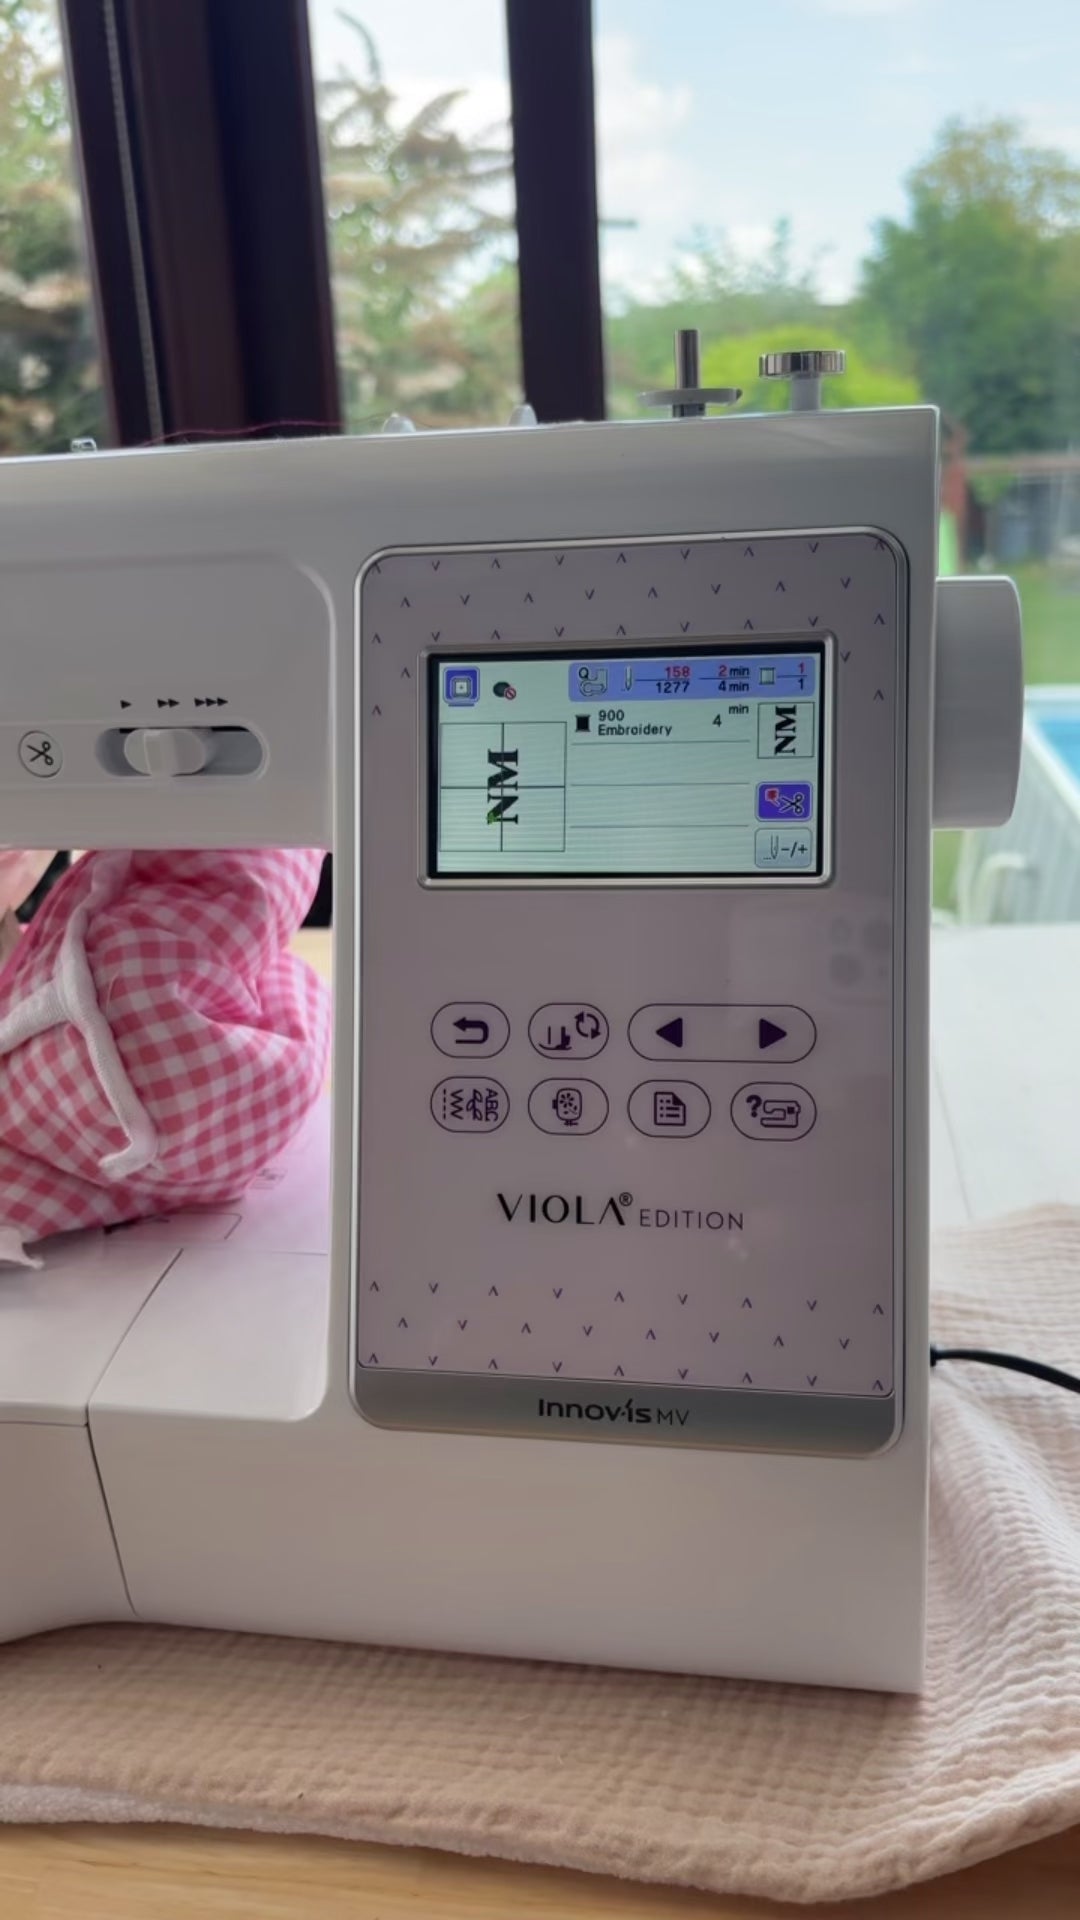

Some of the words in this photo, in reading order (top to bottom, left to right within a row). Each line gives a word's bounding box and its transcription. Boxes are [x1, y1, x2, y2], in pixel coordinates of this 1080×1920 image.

[665, 666, 690, 679] 158
[719, 665, 728, 677] 2
[730, 666, 749, 677] min
[799, 662, 805, 674] 1
[656, 681, 690, 693] 1277
[718, 680, 727, 692] 4
[729, 680, 749, 692] min
[799, 679, 804, 690] 1
[599, 709, 624, 722] 900
[729, 704, 749, 715] min
[712, 714, 722, 727] 4
[598, 723, 672, 736] Embroidery
[484, 1088, 499, 1122] ABC
[639, 1208, 744, 1230] EDITION
[657, 1409, 690, 1426] MV
